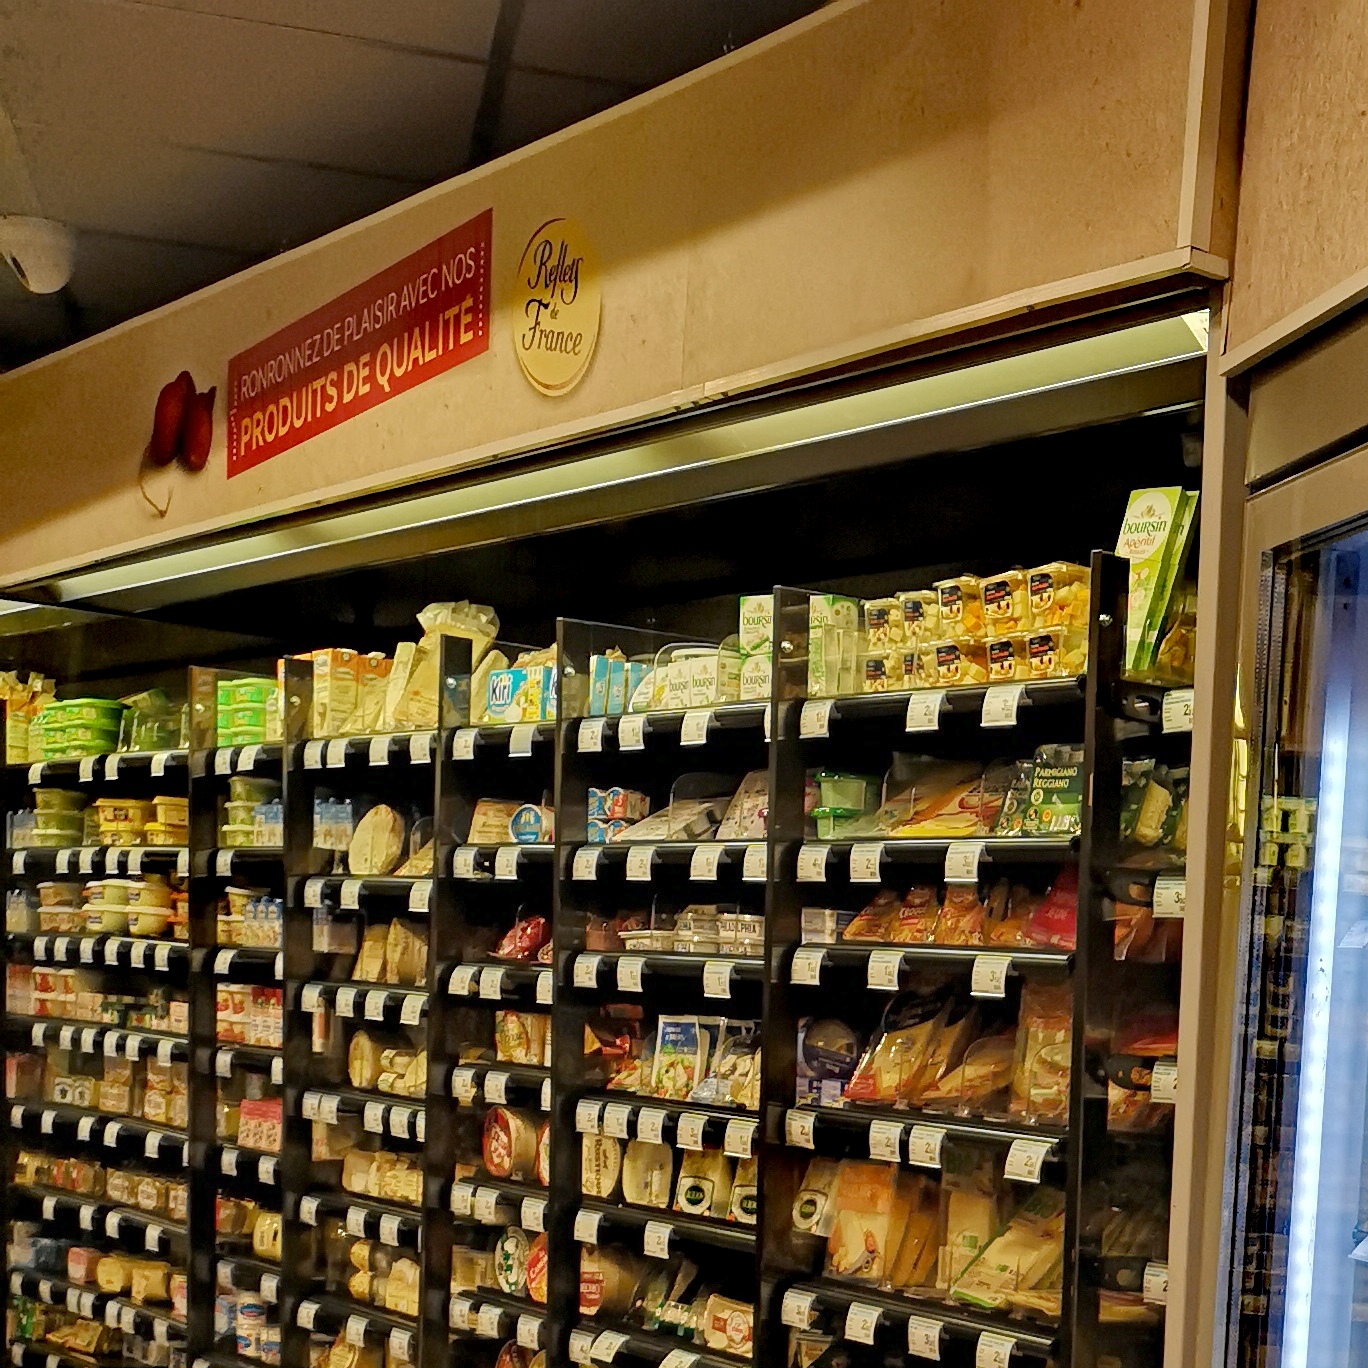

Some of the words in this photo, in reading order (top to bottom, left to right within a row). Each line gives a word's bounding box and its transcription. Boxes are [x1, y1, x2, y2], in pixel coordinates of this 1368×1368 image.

[240, 338, 320, 400] RONRONNEZ
[322, 323, 341, 357] DE
[343, 293, 398, 349] PLAISIR
[399, 268, 439, 317] AVEC
[441, 247, 475, 291] NOS
[240, 376, 337, 456] PRODUITS
[342, 360, 371, 404] DE
[375, 294, 474, 386] QUALITÉ
[522, 299, 582, 357] France
